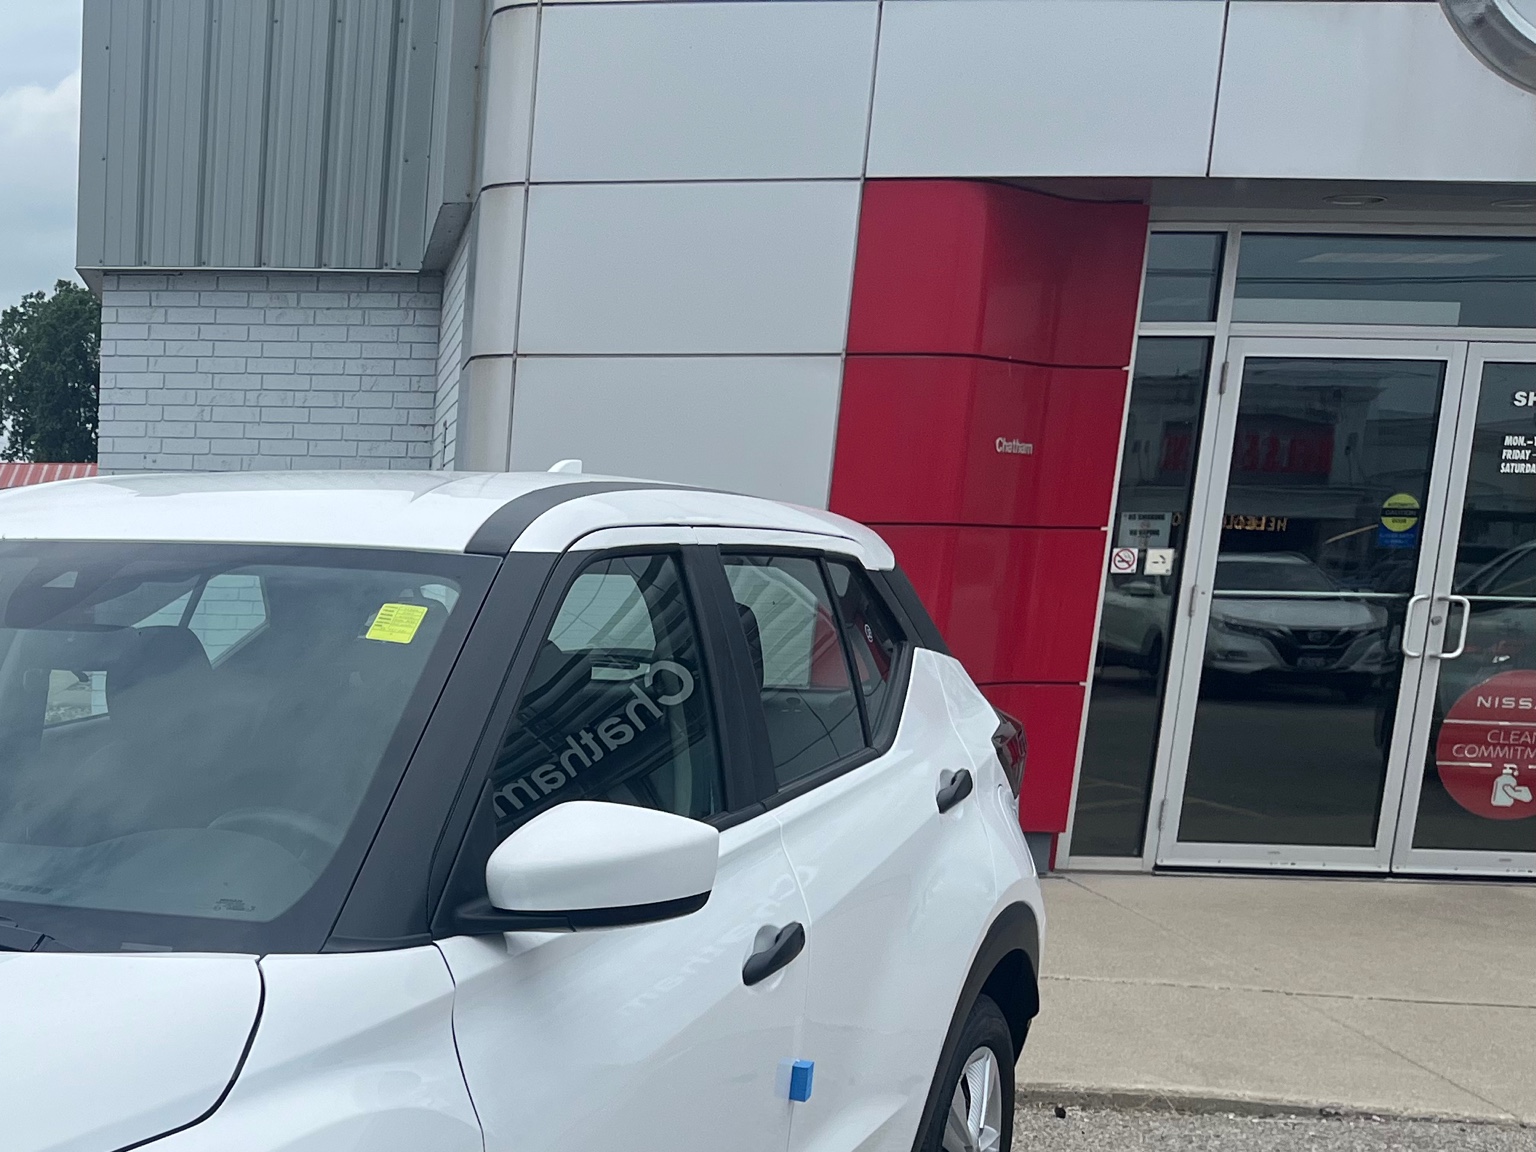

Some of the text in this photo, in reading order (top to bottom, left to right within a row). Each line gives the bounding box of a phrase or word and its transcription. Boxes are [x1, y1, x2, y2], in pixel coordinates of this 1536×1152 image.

[995, 436, 1033, 455] Chatham
[1502, 449, 1531, 460] FRIDAY
[1476, 696, 1536, 710] NISS
